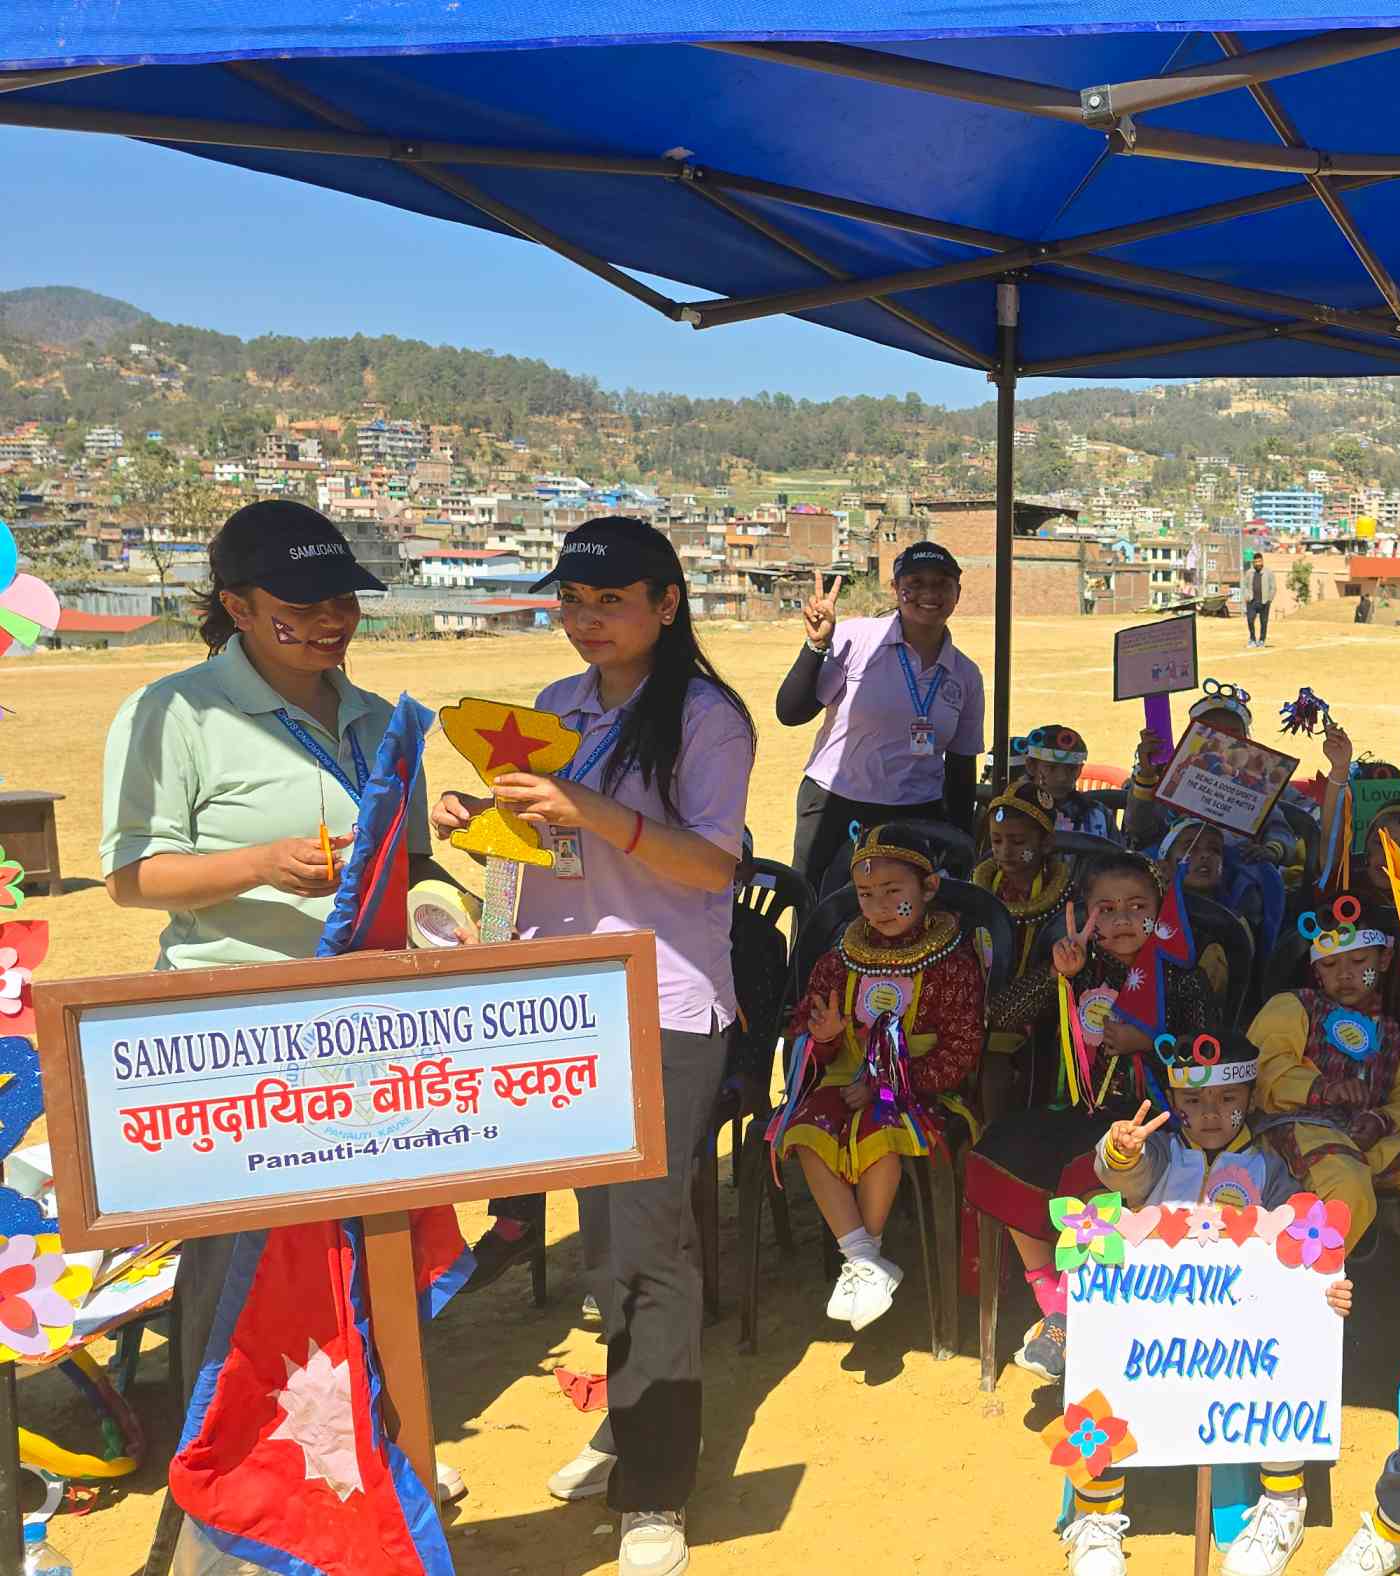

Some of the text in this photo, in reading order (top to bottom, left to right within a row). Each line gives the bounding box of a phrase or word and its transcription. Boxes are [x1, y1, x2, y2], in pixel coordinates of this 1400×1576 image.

[113, 1022, 307, 1080] SAMUDAYIK
[314, 1006, 473, 1058] BOARDING
[484, 993, 597, 1038] SCHOOL
[119, 1077, 355, 1152] सामुदायिक
[491, 1054, 598, 1109] स्कूल
[1071, 1263, 1243, 1306] SAMUDAYIK
[1123, 1337, 1280, 1382] BOARDING
[1198, 1400, 1332, 1446] SCHOOL
